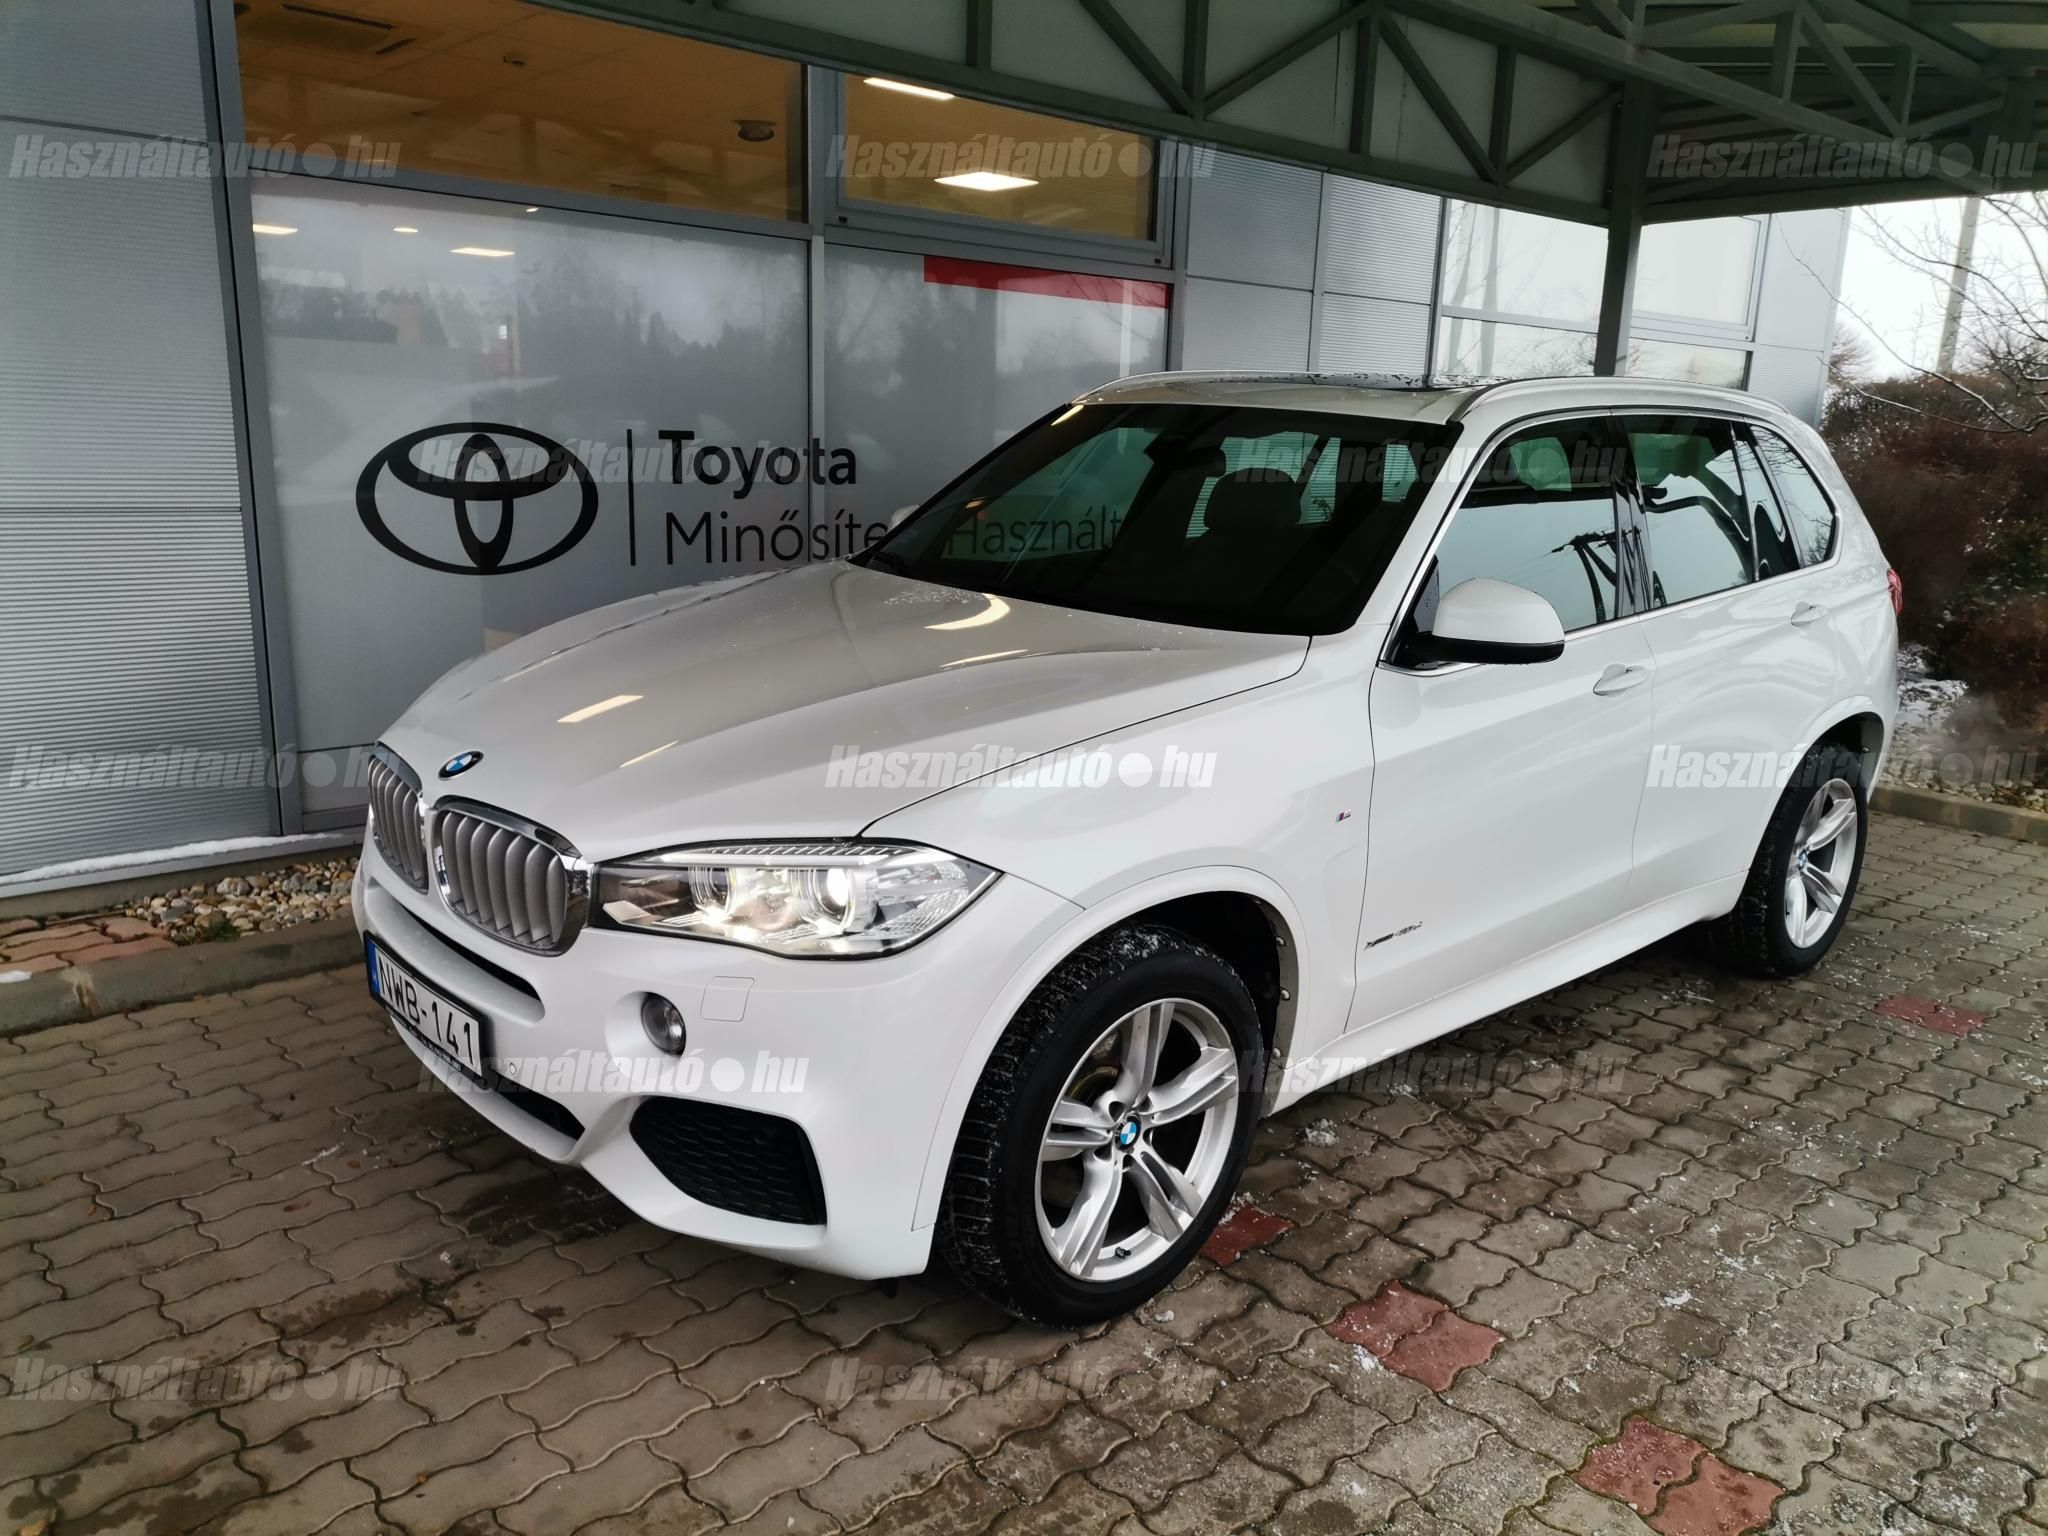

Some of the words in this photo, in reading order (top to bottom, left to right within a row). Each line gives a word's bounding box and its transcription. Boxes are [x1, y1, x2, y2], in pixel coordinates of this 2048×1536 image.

[658, 429, 857, 499] Toyota
[665, 507, 890, 565] Minősíte
[378, 957, 474, 1066] NWB-141
